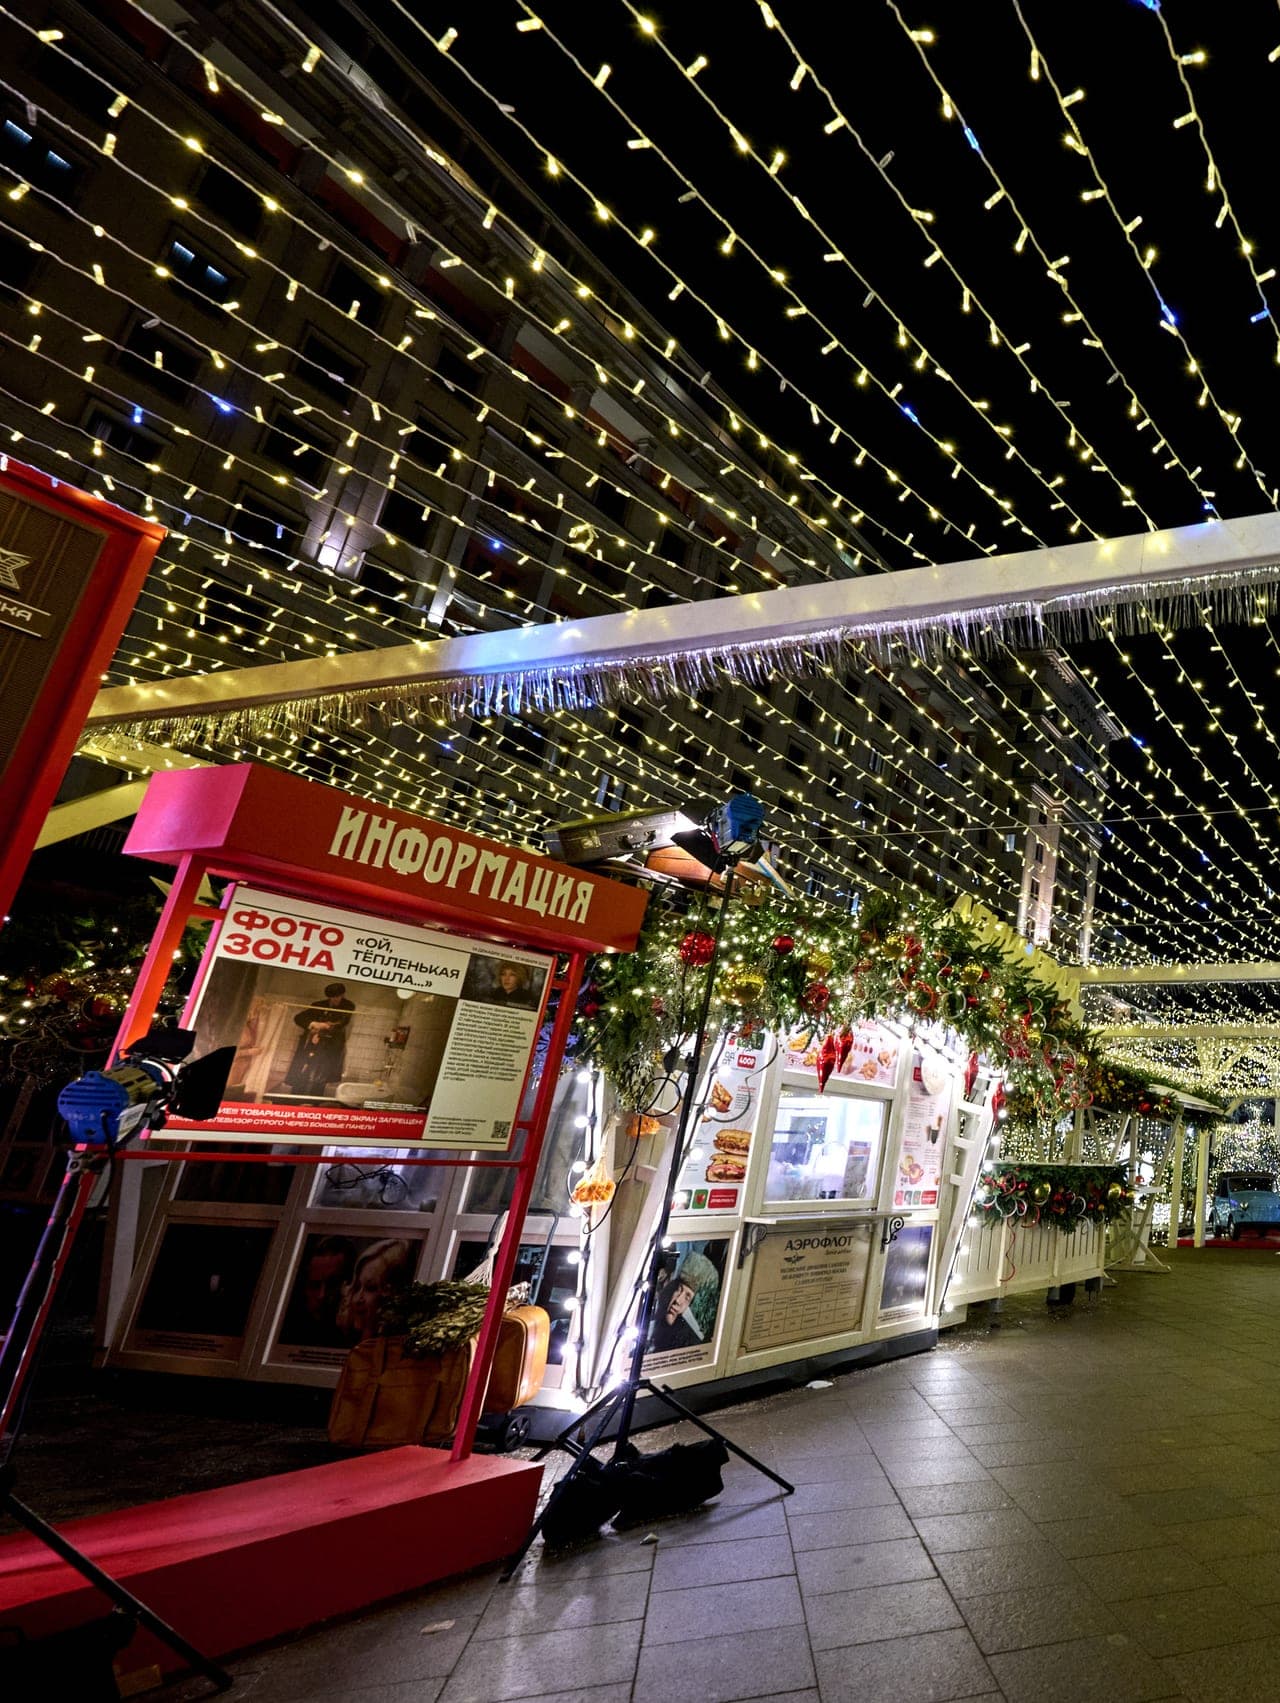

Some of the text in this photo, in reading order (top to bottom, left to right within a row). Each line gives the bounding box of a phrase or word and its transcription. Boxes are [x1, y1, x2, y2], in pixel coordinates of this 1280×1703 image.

[328, 806, 595, 924] ИНФОРМАЦИЯ
[232, 910, 344, 947] ФОТО
[223, 933, 335, 971] ЗОНА
[356, 936, 394, 954] «ОЙ,
[347, 964, 434, 989] ПОШЛА...»
[352, 949, 461, 980] ТЁПЛЕНЬКАЯ
[253, 1118, 284, 1126] СТРОГО
[285, 1120, 309, 1128] ЧЕРЕЗ
[310, 1121, 345, 1129] БОКОВЫЕ
[345, 1123, 376, 1131] ПАНЕЛИ
[322, 1112, 350, 1121] ЧЕРЕЗ
[350, 1113, 378, 1123] ЭКРАН
[784, 1236, 854, 1251] АЭРОФЛОТ
